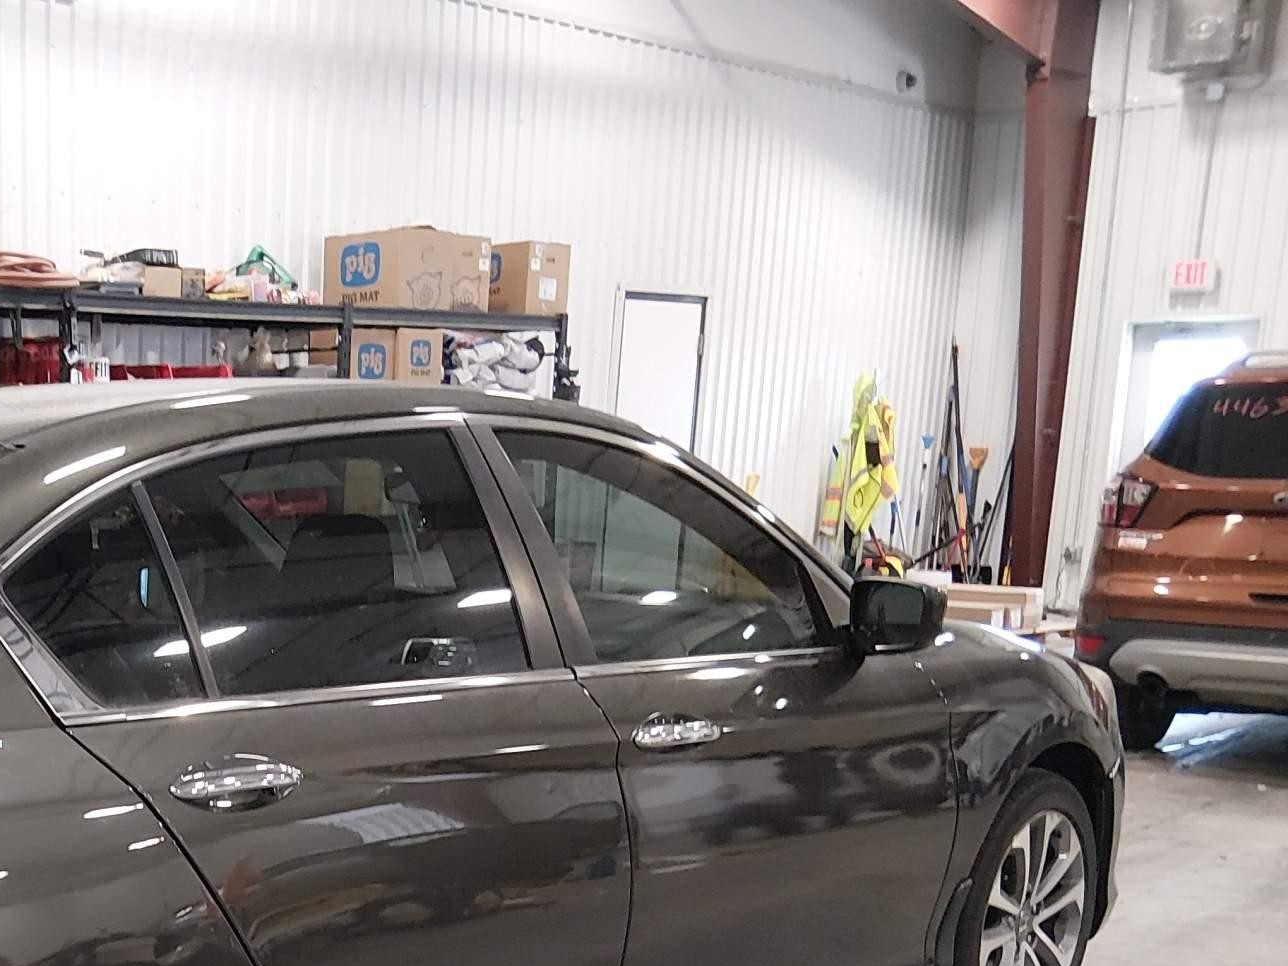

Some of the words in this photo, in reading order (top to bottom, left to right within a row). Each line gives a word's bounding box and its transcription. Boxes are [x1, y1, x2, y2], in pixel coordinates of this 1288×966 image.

[345, 247, 376, 282] pig
[1174, 261, 1208, 286] EXIT
[359, 290, 380, 302] MAT
[361, 346, 383, 375] pig
